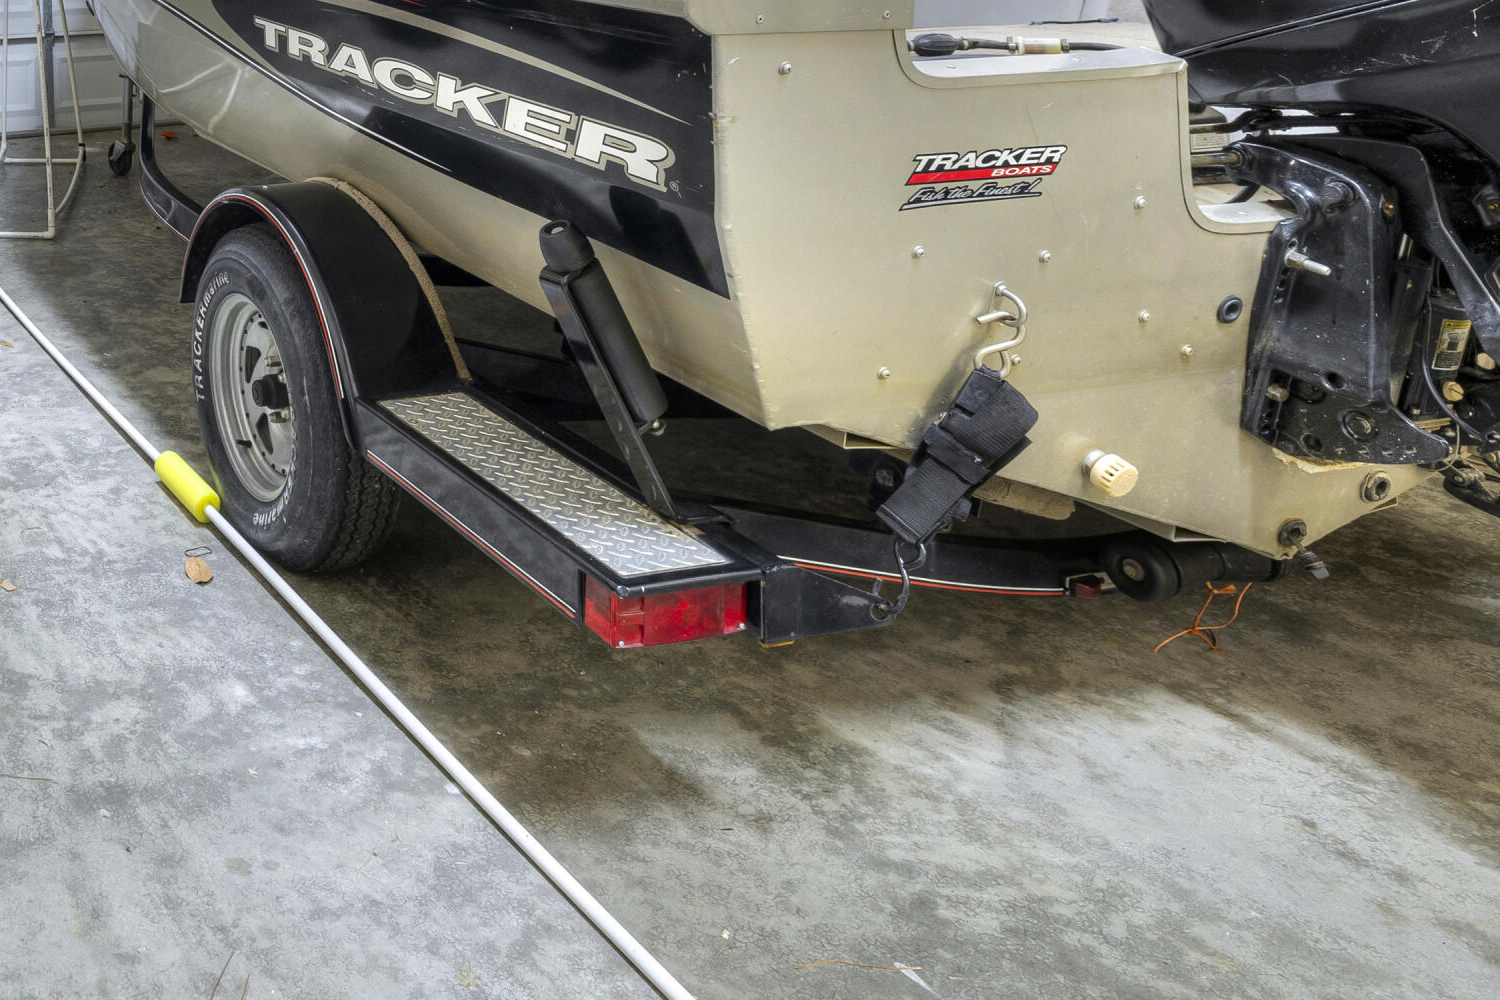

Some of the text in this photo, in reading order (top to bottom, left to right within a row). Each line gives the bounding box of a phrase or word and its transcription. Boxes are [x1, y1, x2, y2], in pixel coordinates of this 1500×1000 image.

[254, 15, 676, 192] TRACKER
[913, 146, 1067, 173] TRACKER
[991, 164, 1053, 177] BOATS
[909, 187, 946, 203] Fish
[946, 185, 973, 199] the
